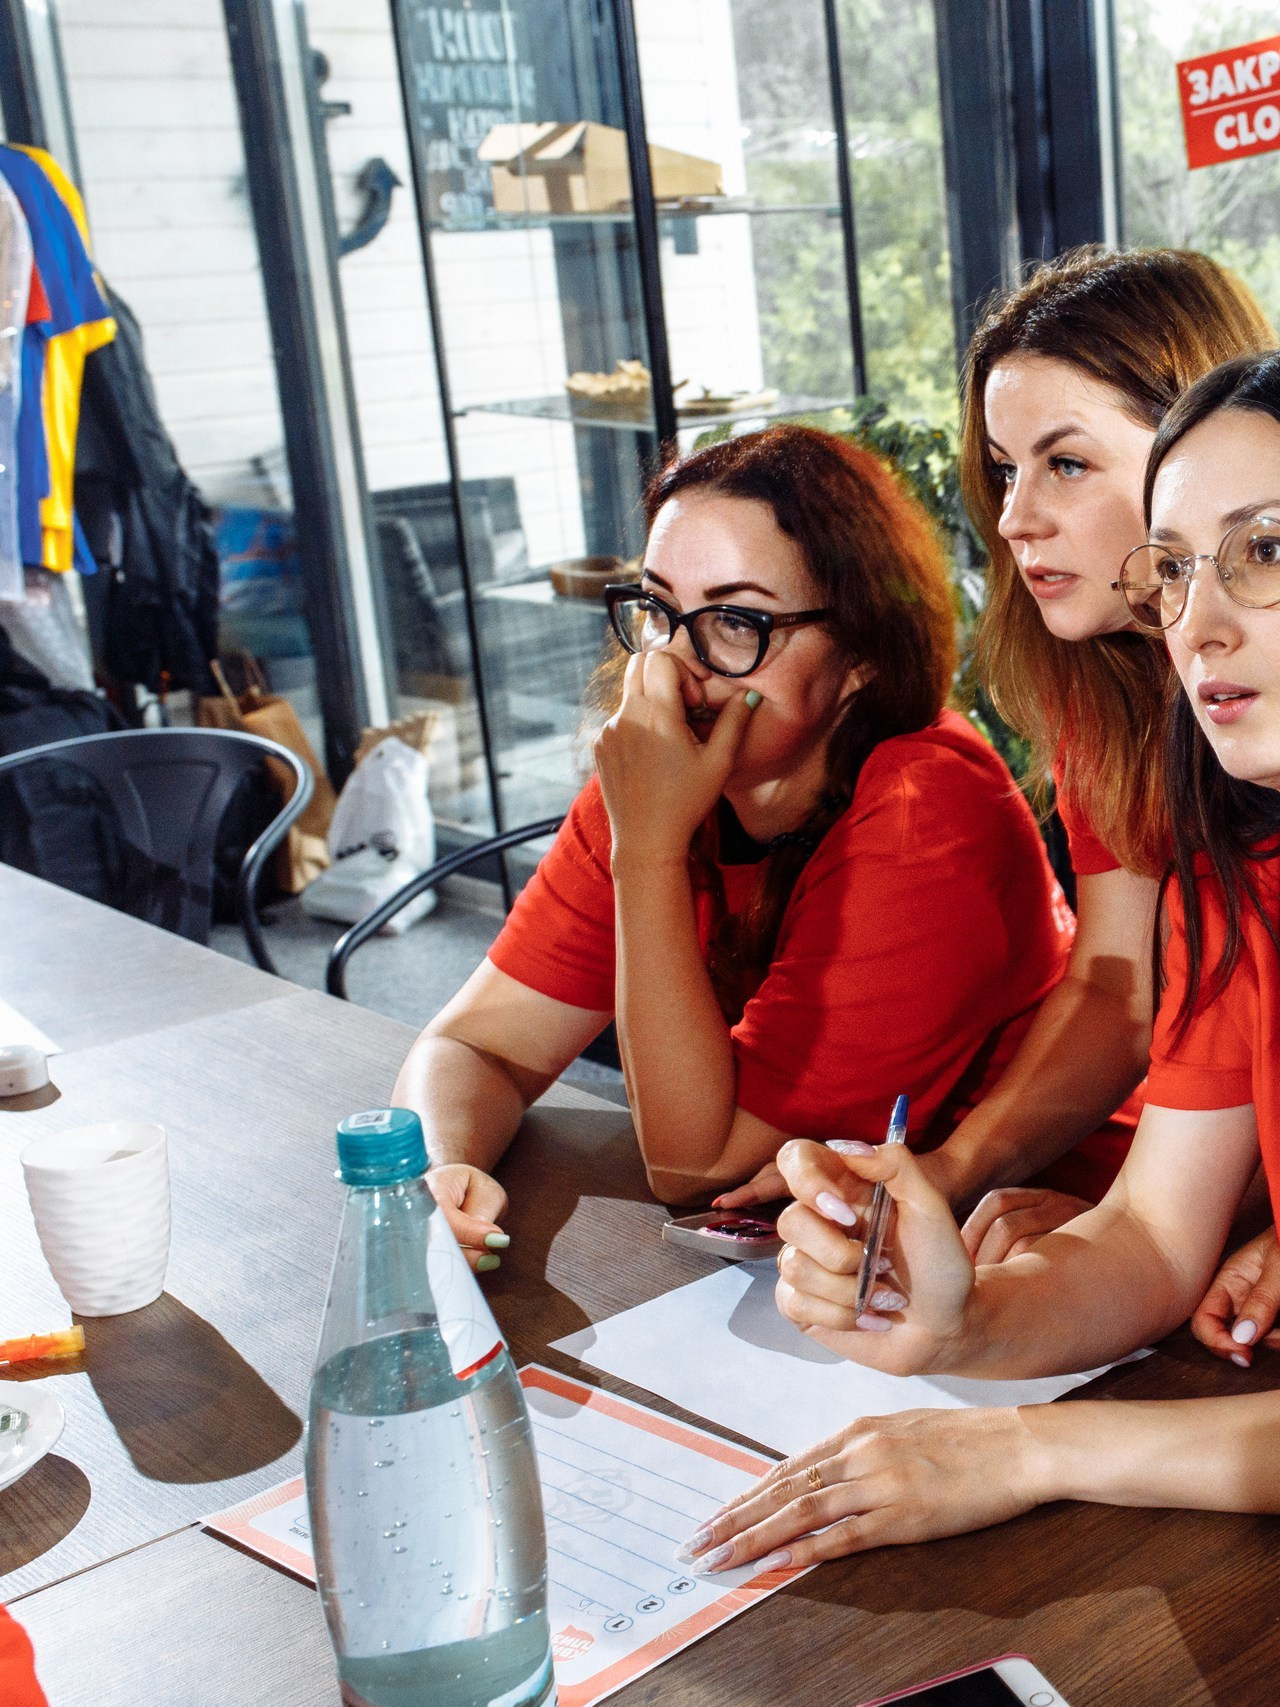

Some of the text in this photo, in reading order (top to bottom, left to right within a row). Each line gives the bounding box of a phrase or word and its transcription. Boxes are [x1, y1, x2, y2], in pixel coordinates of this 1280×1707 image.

[674, 1581, 690, 1591] 3
[642, 1600, 659, 1610] 2
[611, 1619, 626, 1629] 1
